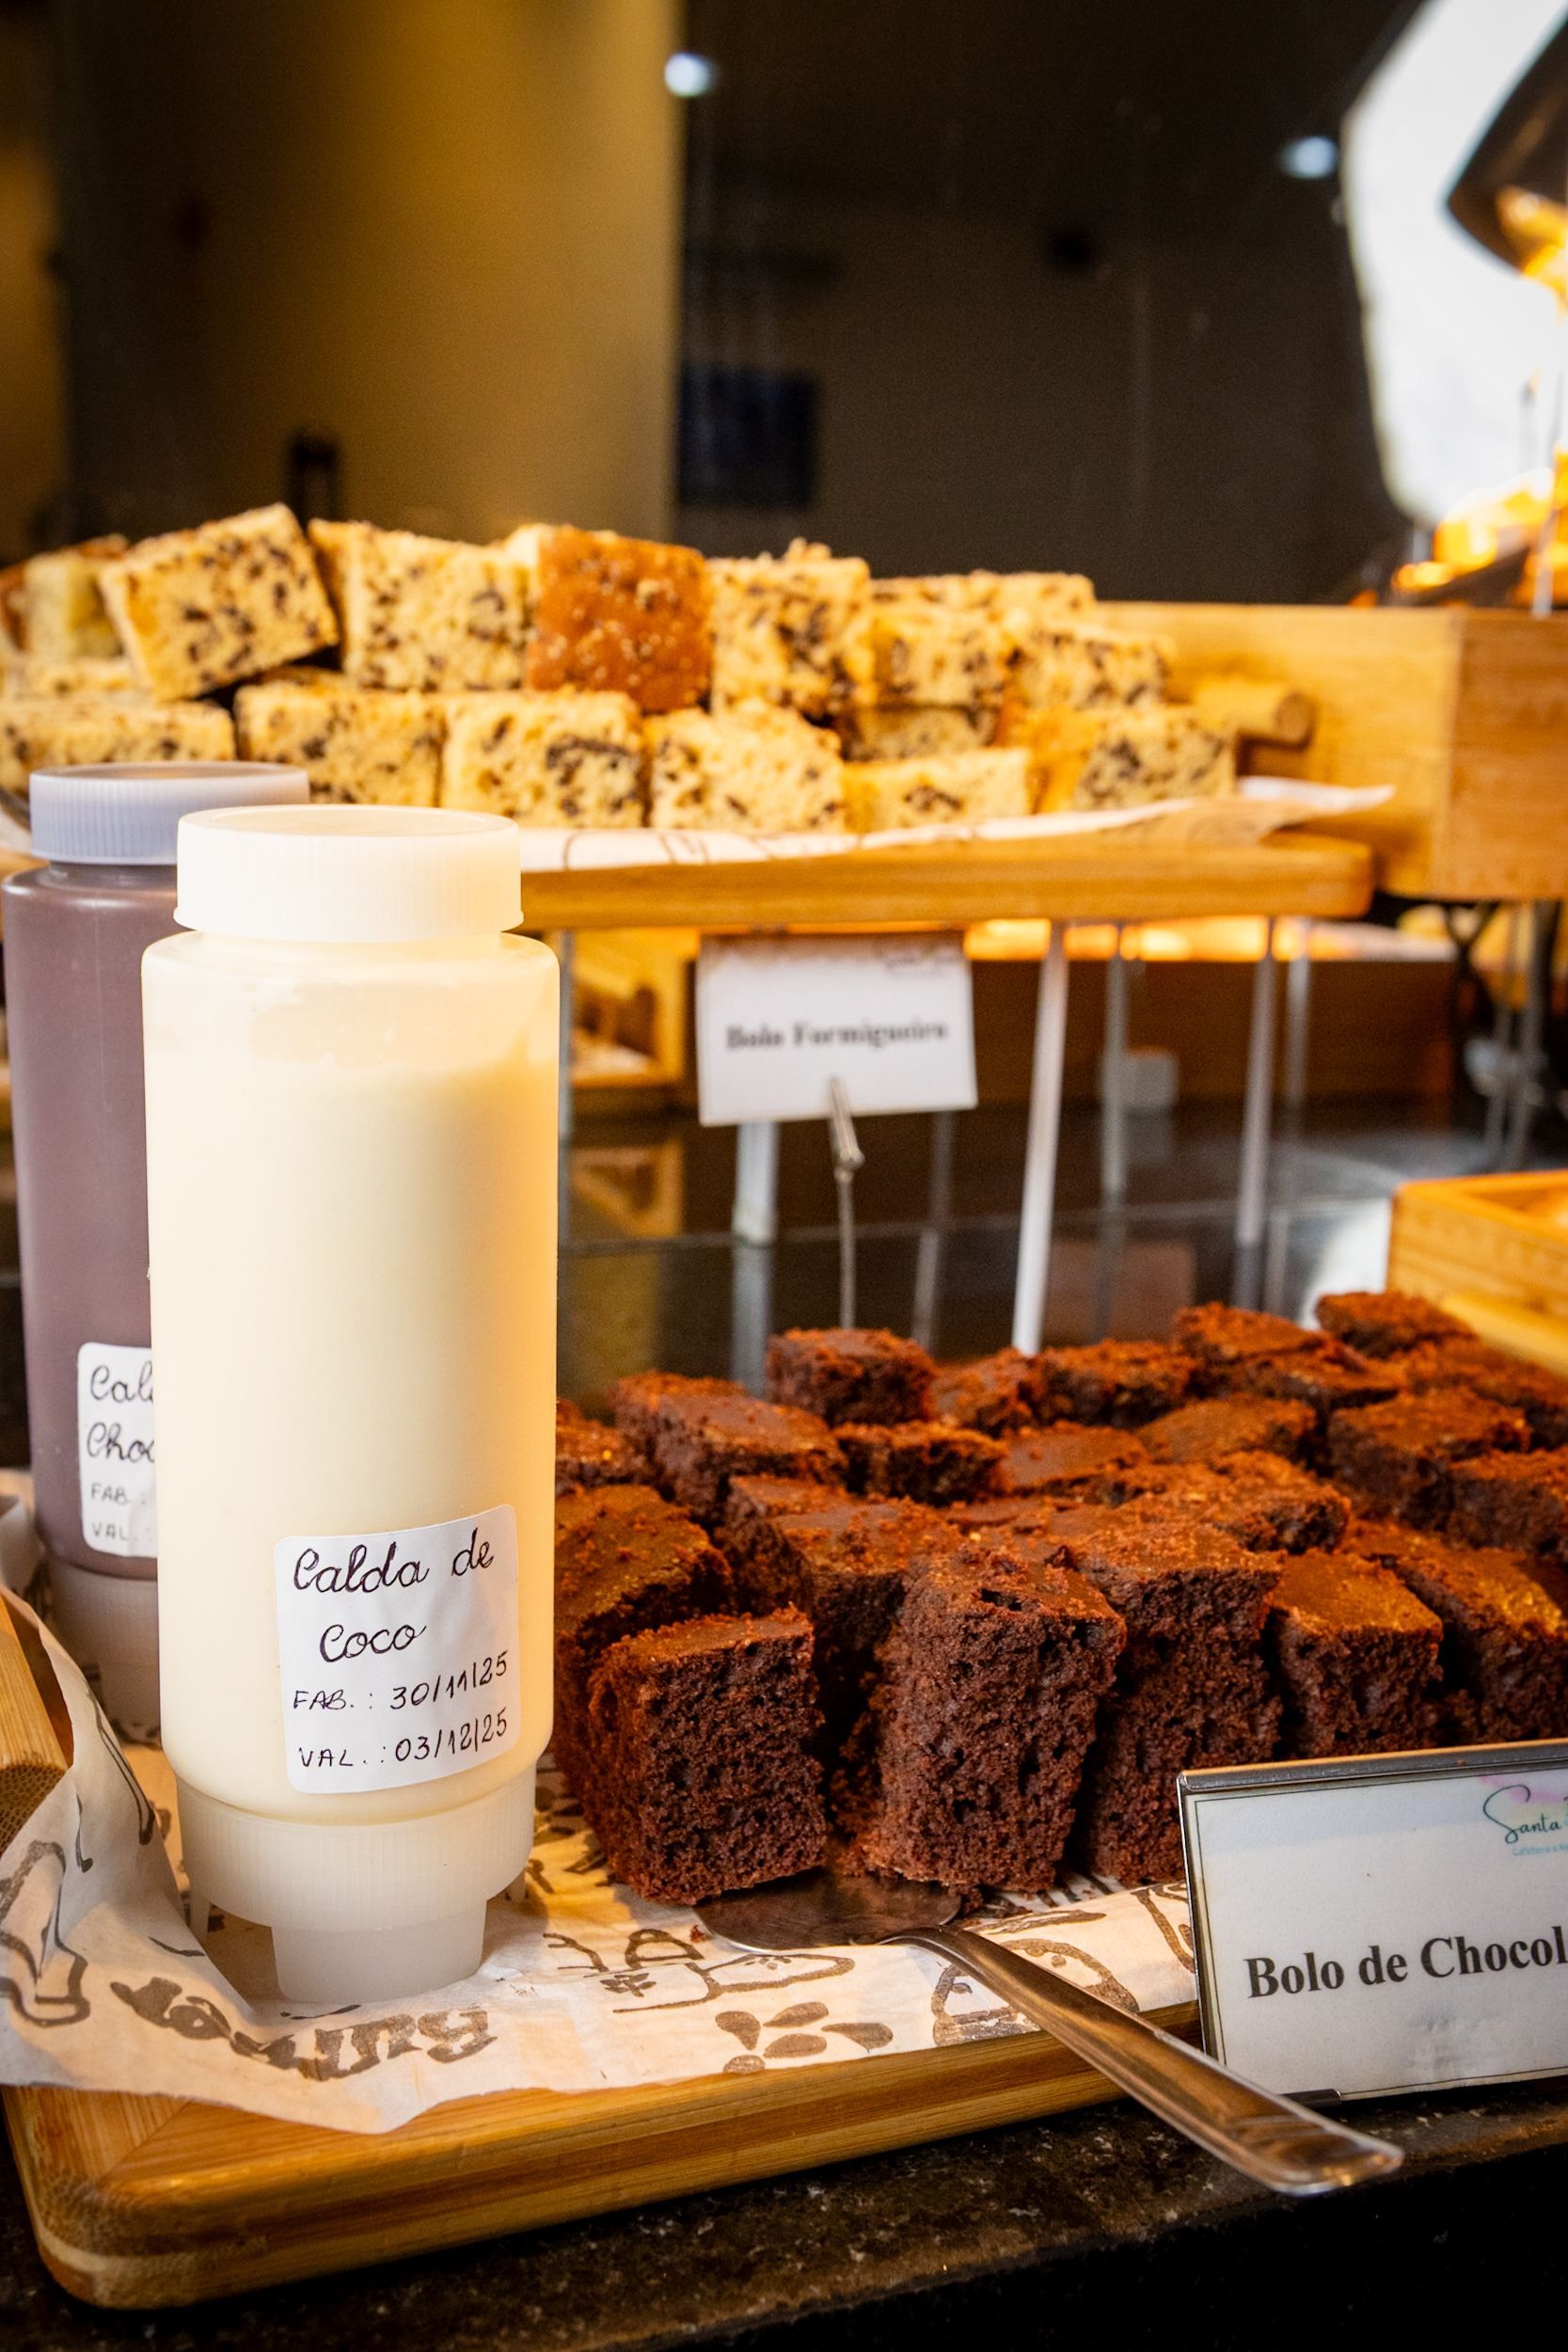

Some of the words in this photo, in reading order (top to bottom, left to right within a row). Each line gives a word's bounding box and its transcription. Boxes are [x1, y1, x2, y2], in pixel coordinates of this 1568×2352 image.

[90, 1359, 153, 1403] Cal
[293, 1541, 430, 1593] Calda
[451, 1527, 494, 1576] de
[319, 1624, 427, 1662] Coco
[1482, 1784, 1562, 1844] Santa
[1243, 1952, 1345, 1998] Bolo
[1358, 1946, 1409, 1985] de
[1420, 1926, 1568, 1979] Chocol
